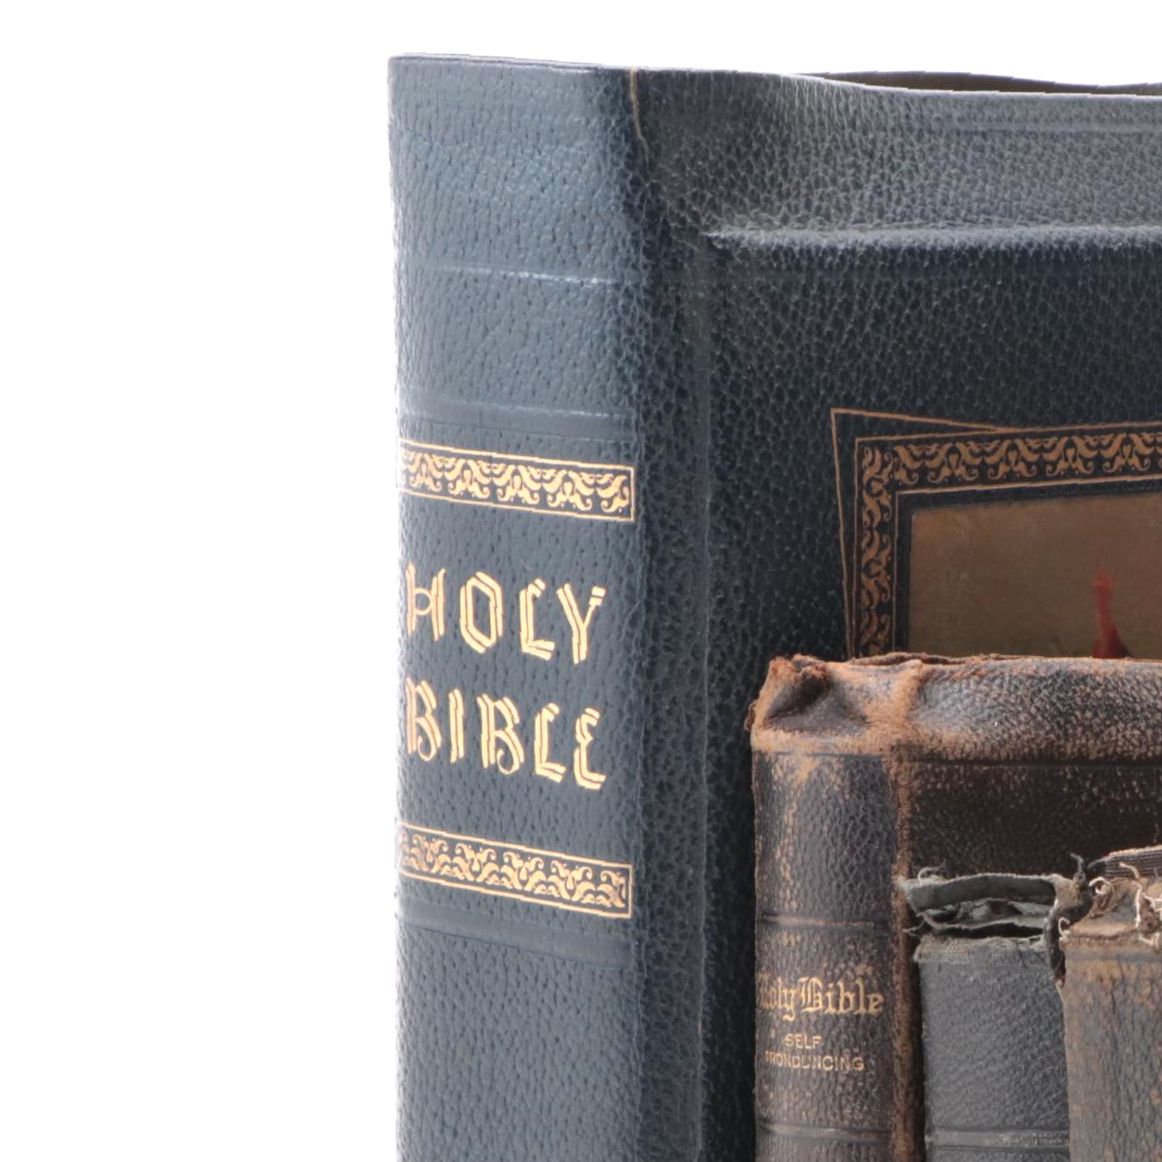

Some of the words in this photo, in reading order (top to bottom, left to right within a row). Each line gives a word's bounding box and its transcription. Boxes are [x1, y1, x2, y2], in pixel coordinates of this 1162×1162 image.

[405, 561, 606, 664] HOLY
[405, 678, 607, 790] BIBLE
[798, 976, 884, 1016] Bible
[784, 1033, 822, 1050] SELF
